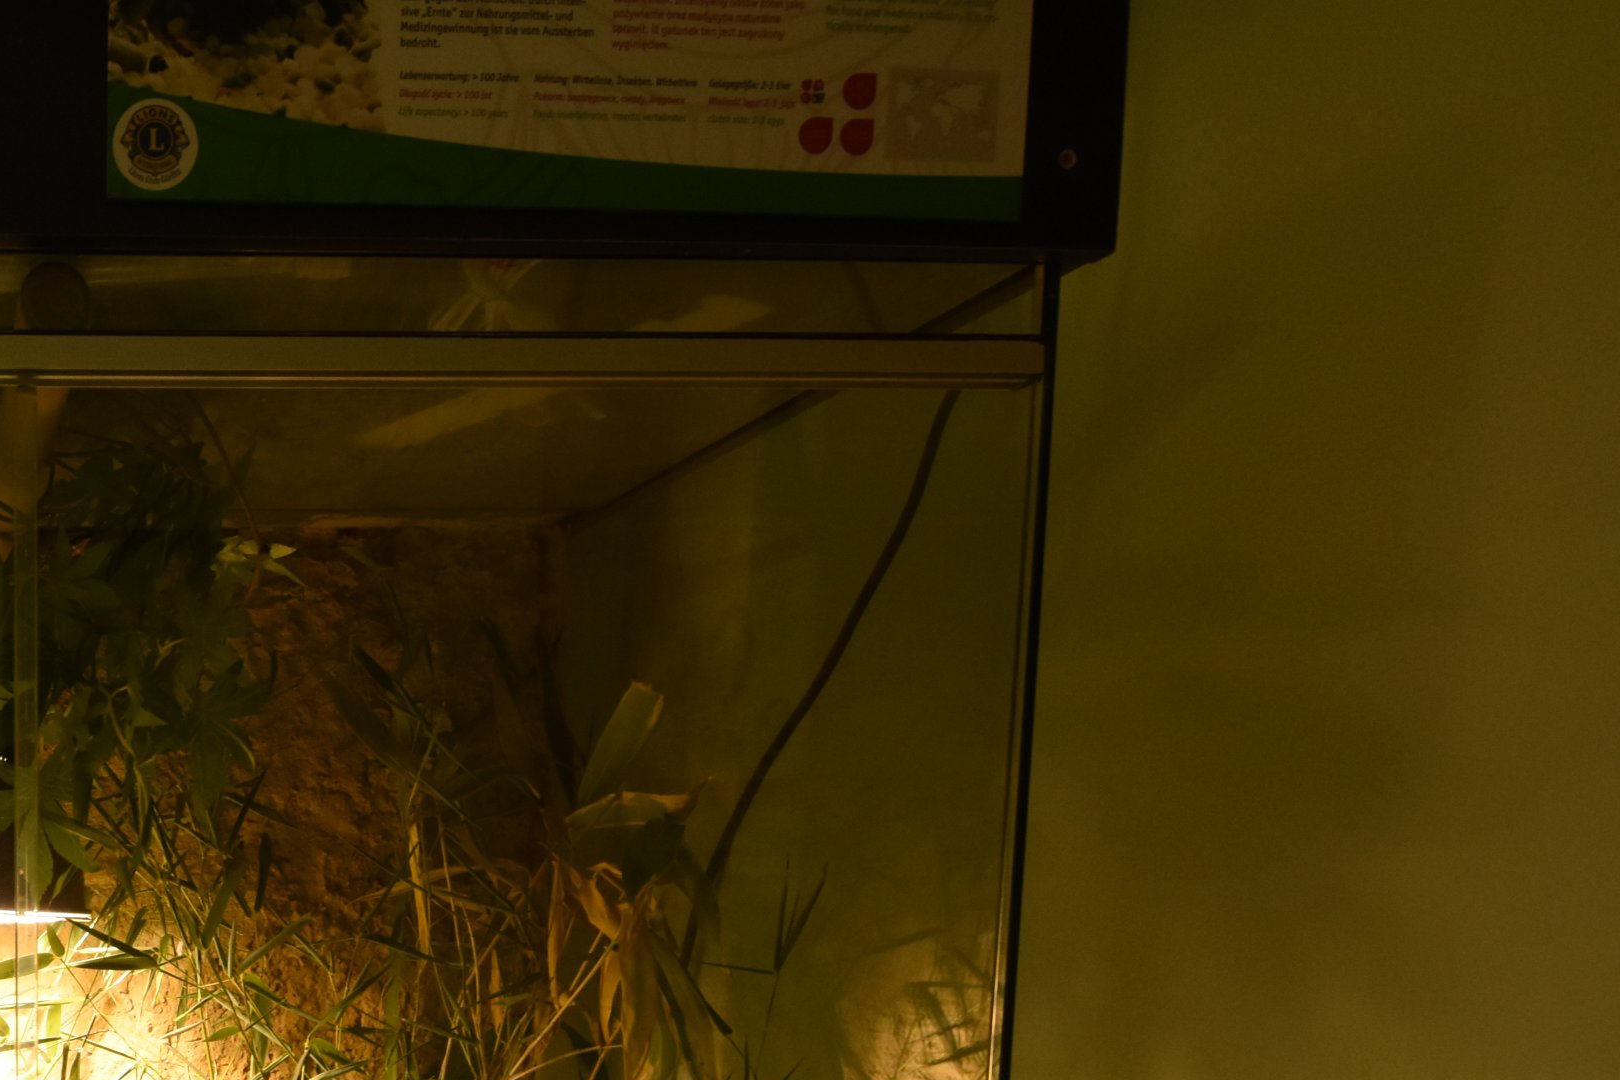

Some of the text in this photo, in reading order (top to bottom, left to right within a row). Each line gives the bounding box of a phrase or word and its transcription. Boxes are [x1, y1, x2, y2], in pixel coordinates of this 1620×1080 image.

[400, 7, 419, 17] sive
[459, 9, 474, 18] zur
[476, 8, 553, 22] Nahrungsmittel-
[556, 11, 573, 21] und
[400, 21, 594, 37] Medizingewinnung ist sie vom Aussterben
[399, 37, 440, 48] bedroht.
[399, 71, 468, 84] Lebenserwartung:
[479, 72, 496, 82] 100
[136, 108, 175, 123] LIONS
[148, 127, 165, 151] L
